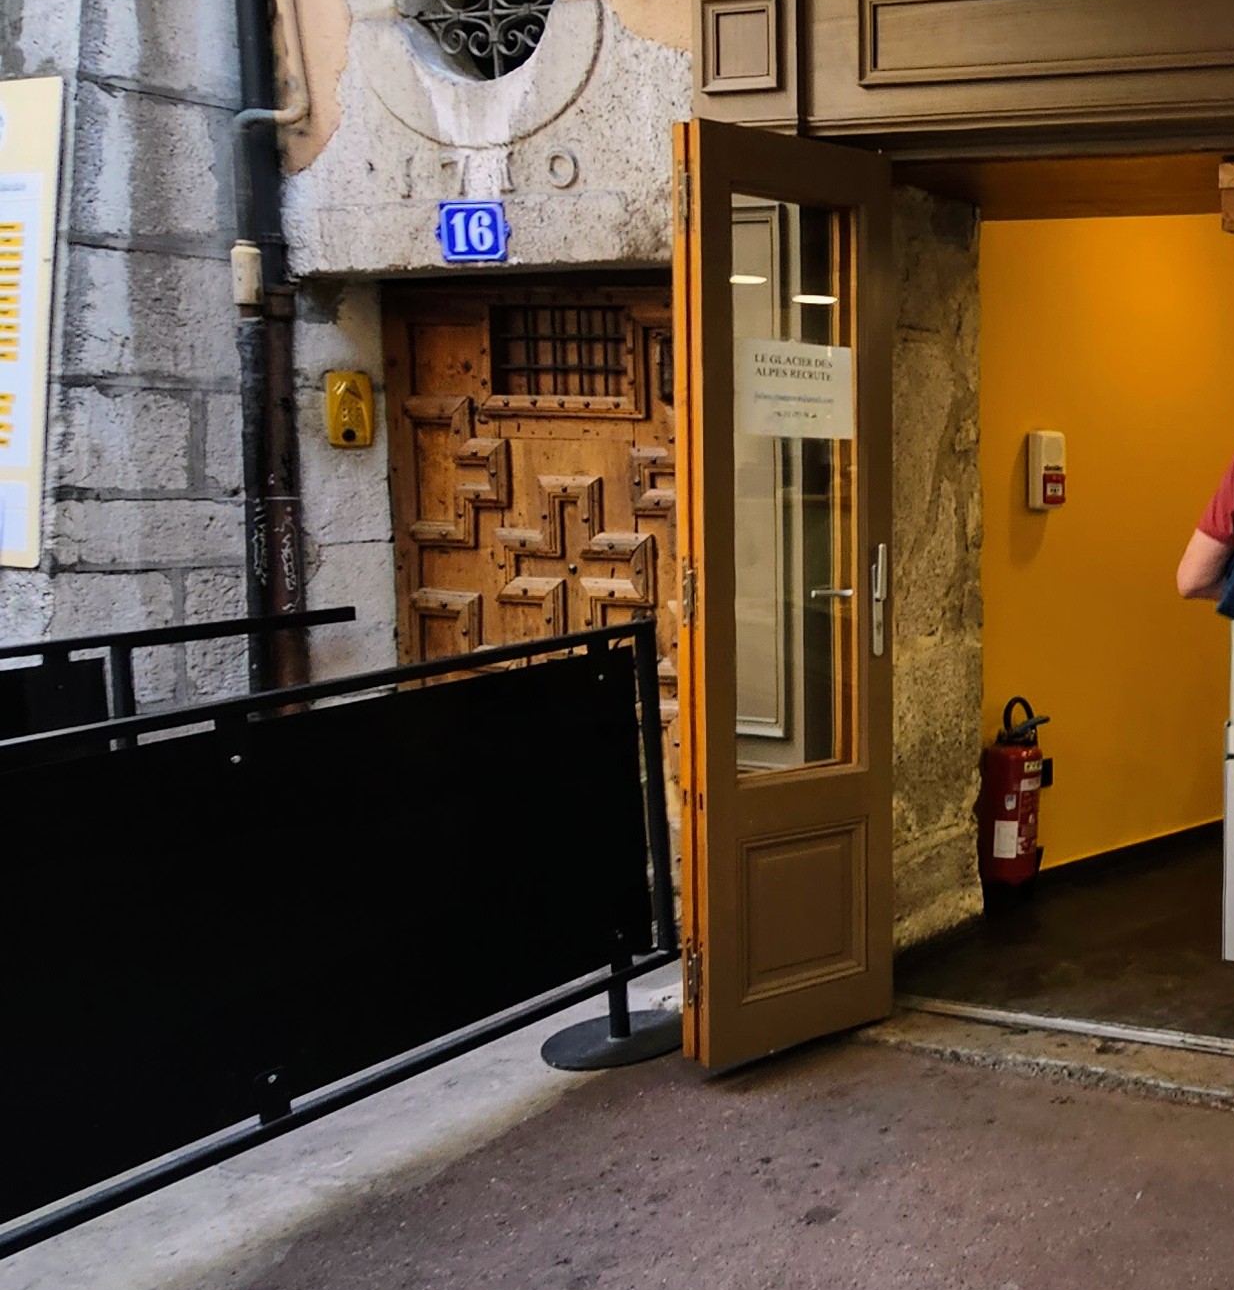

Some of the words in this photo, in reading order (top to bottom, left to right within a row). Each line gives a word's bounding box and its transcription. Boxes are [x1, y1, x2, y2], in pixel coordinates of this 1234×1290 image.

[451, 210, 495, 252] 16
[755, 354, 766, 363] LE
[769, 354, 812, 368] GLACIER
[815, 358, 833, 369] DES
[755, 367, 788, 378] ALPES
[790, 369, 832, 382] RECRUTE
